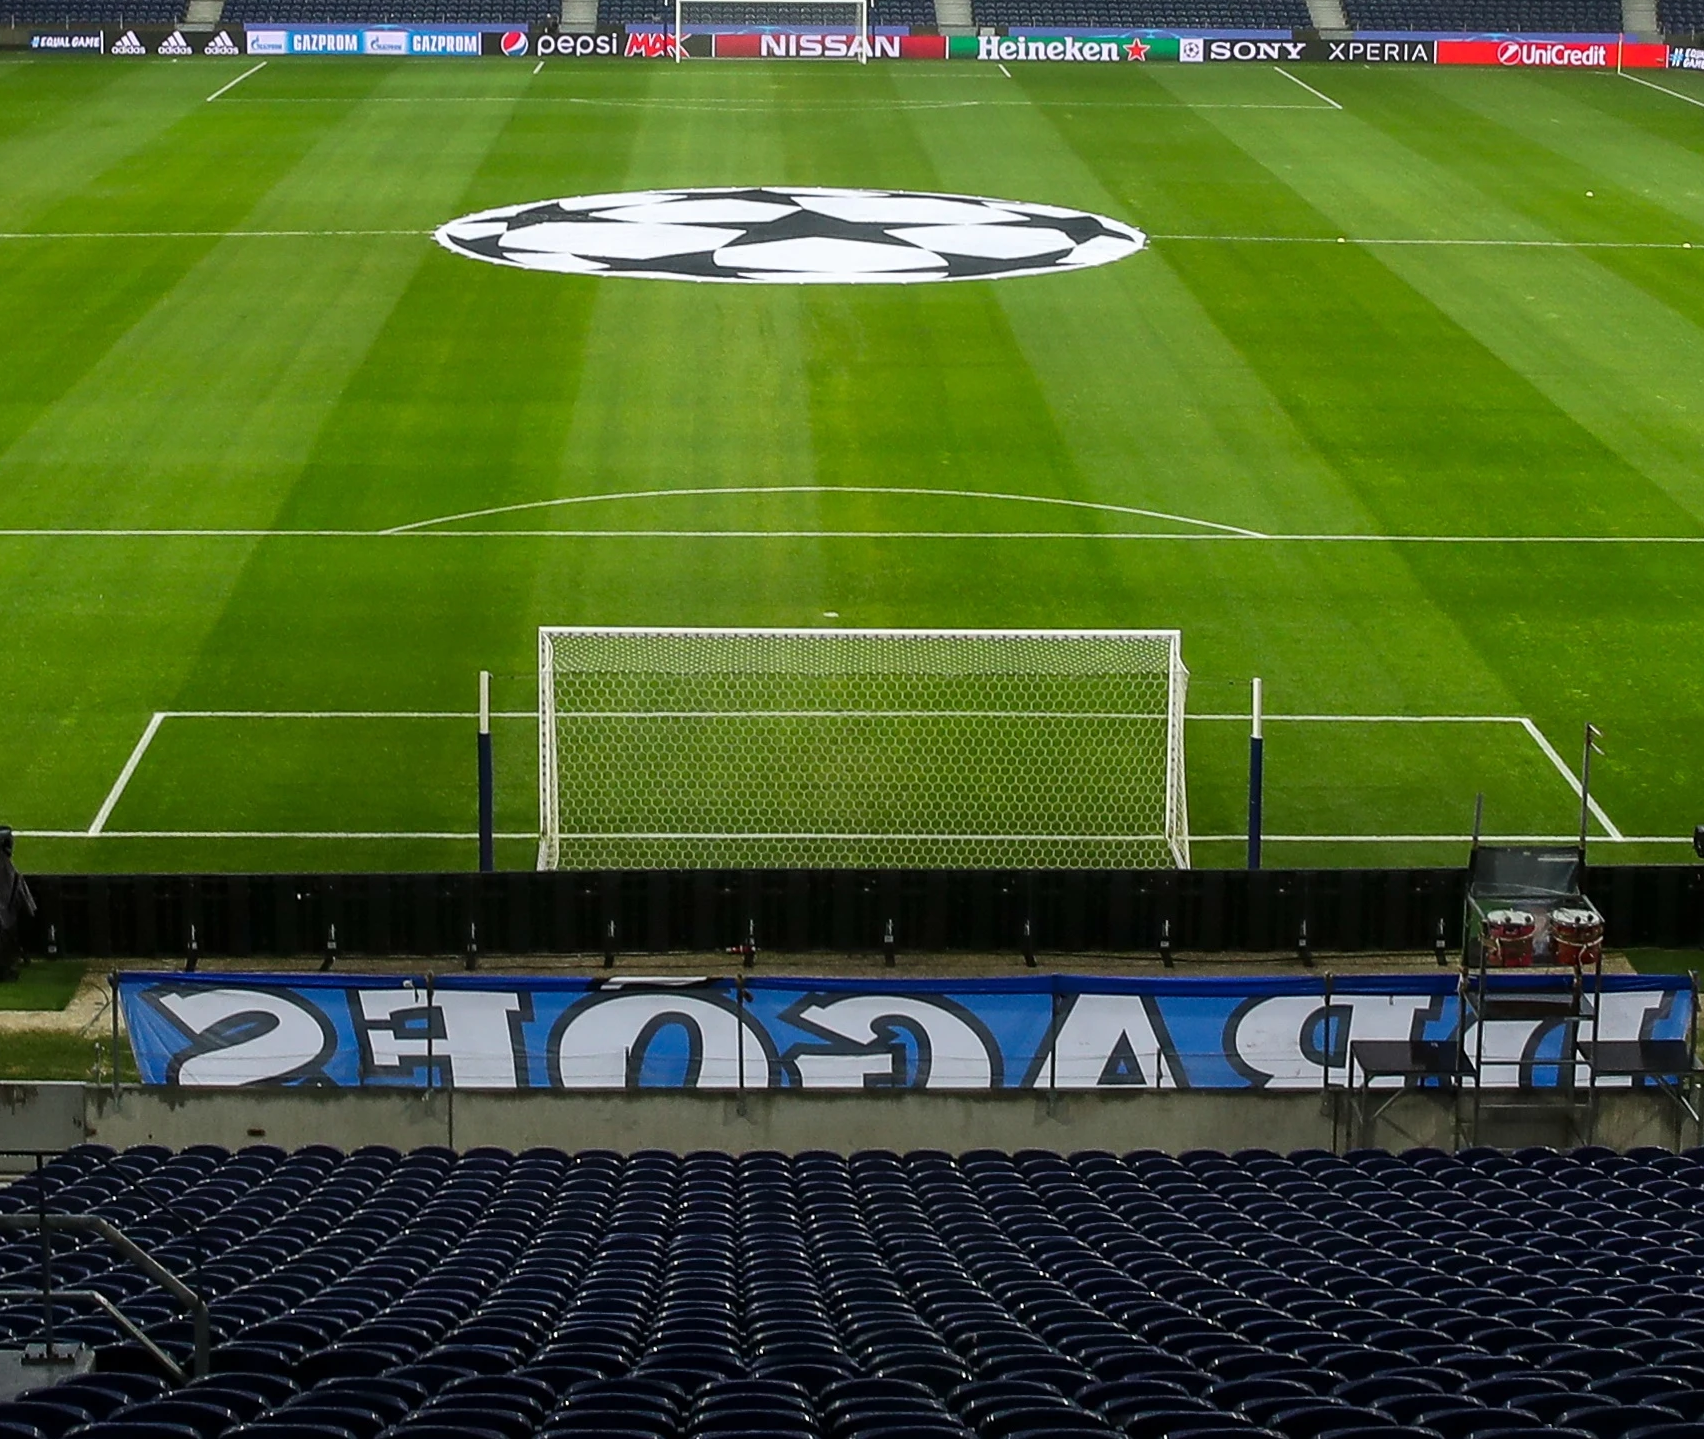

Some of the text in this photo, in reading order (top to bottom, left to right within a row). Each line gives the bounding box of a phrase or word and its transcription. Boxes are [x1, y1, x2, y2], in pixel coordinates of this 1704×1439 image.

[293, 34, 358, 52] GAZPROM
[412, 35, 477, 53] GAZPROM
[536, 33, 618, 57] pepsi
[760, 34, 900, 58] NISSAN
[976, 35, 1120, 62] Heineken
[1209, 41, 1429, 62] SONY XPERIA
[1521, 43, 1607, 67] UniCredit
